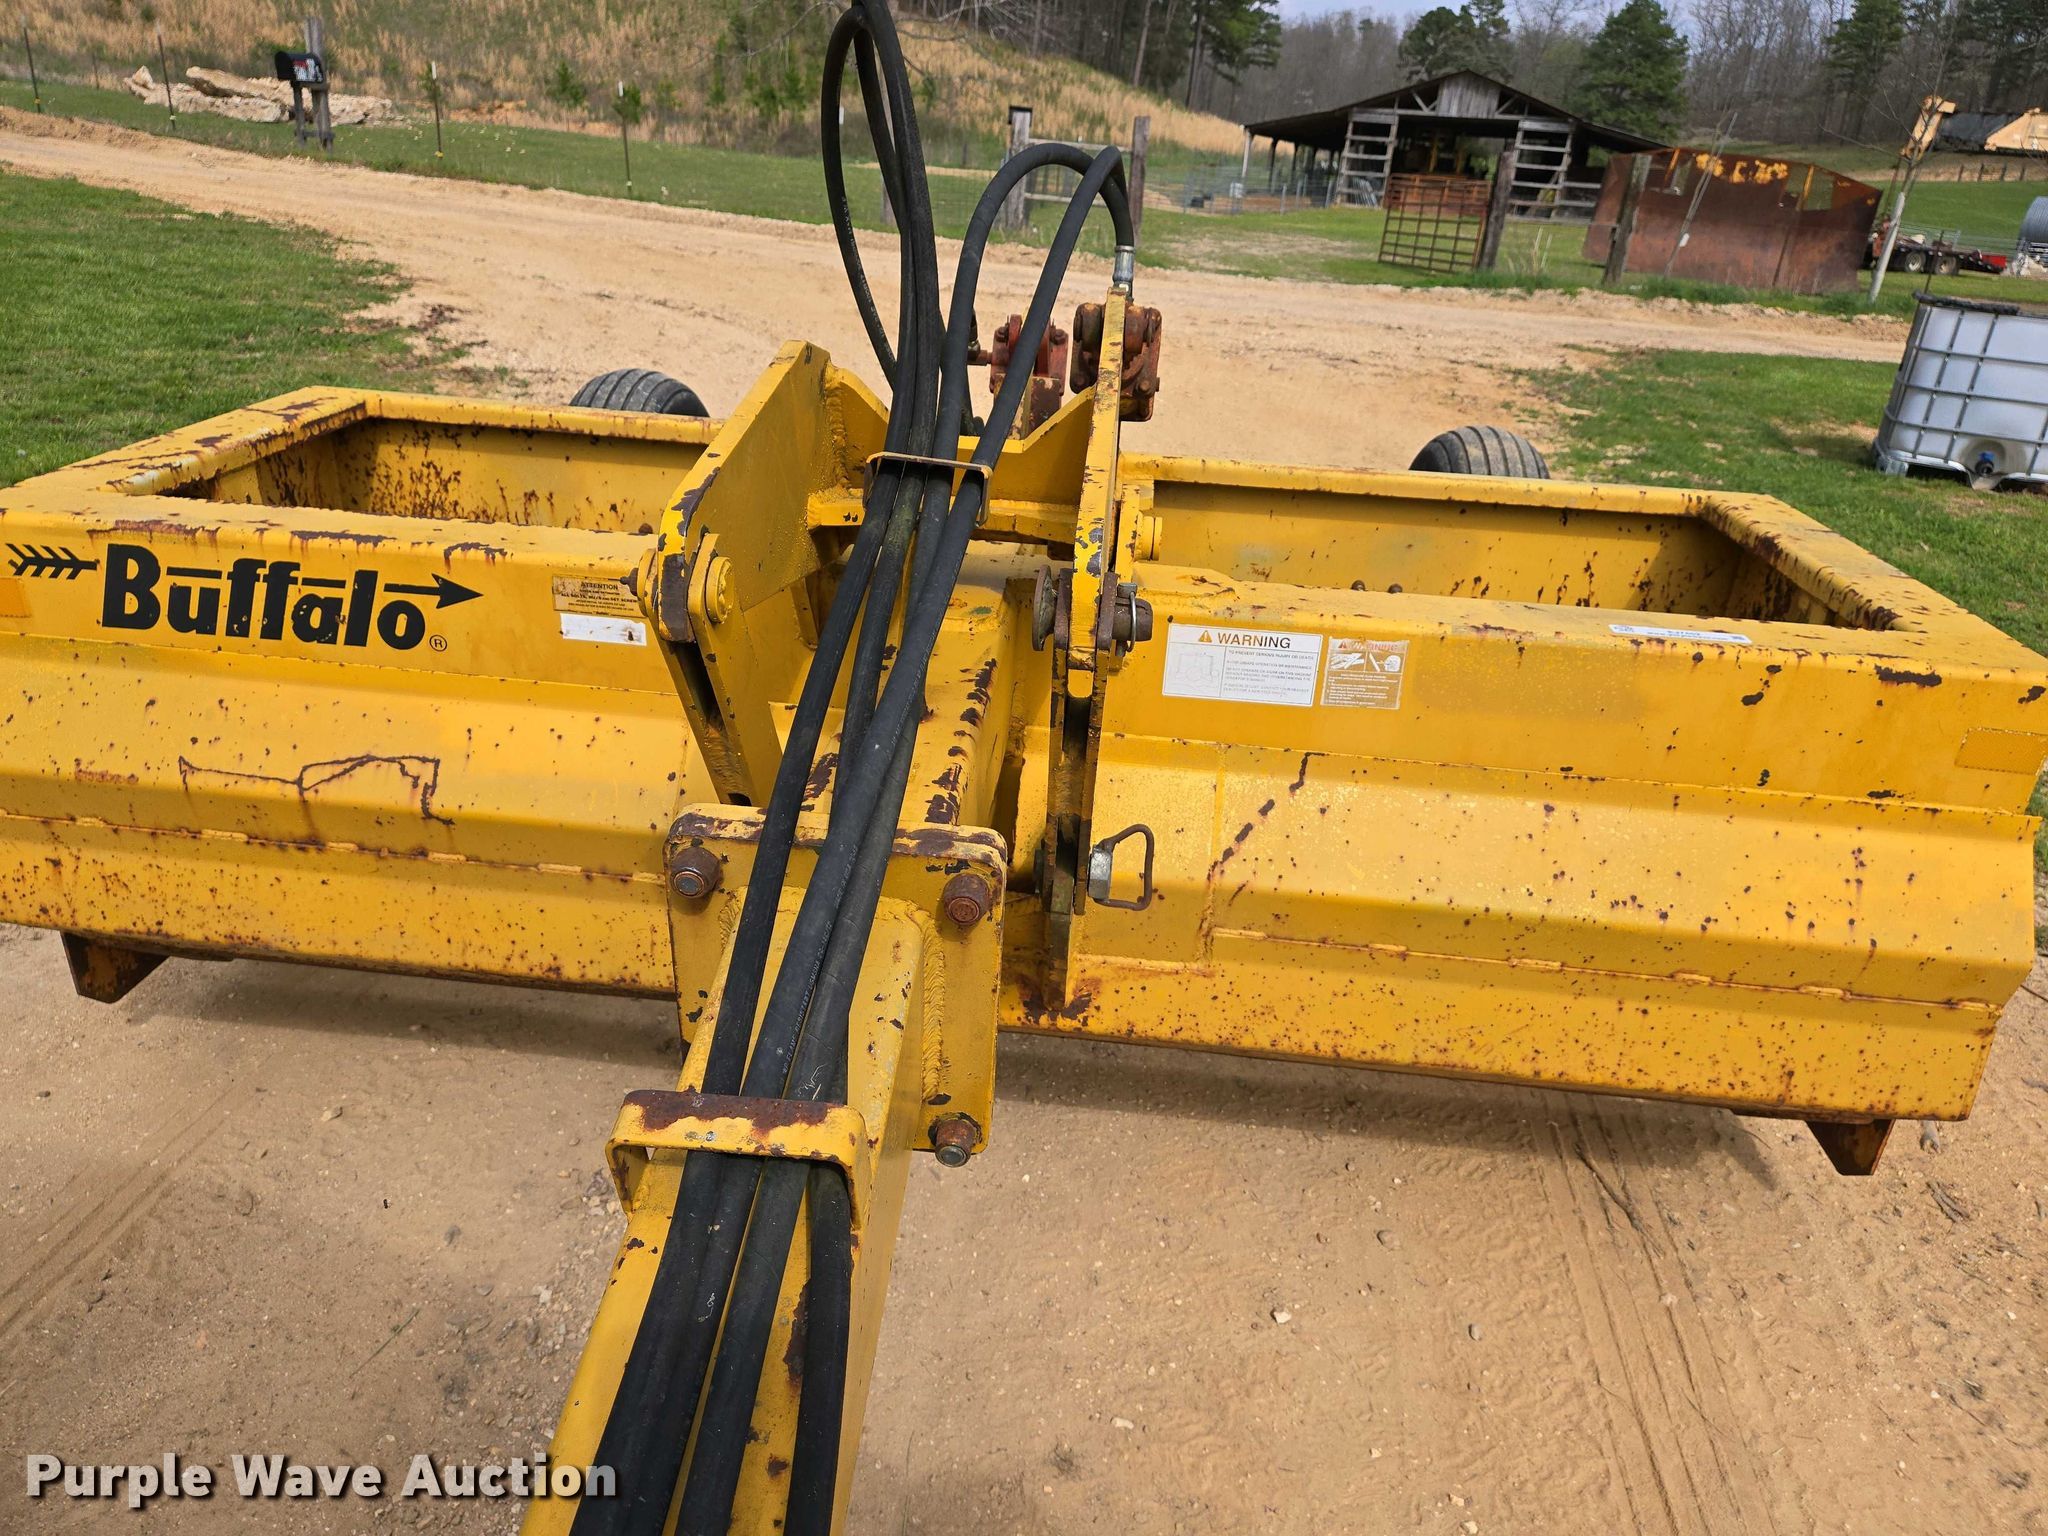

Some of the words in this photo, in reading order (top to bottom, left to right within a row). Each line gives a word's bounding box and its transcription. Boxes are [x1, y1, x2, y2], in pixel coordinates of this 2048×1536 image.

[580, 581, 619, 590] ATTENTION
[102, 543, 426, 650] Buffalo
[1217, 632, 1292, 649] WARNING
